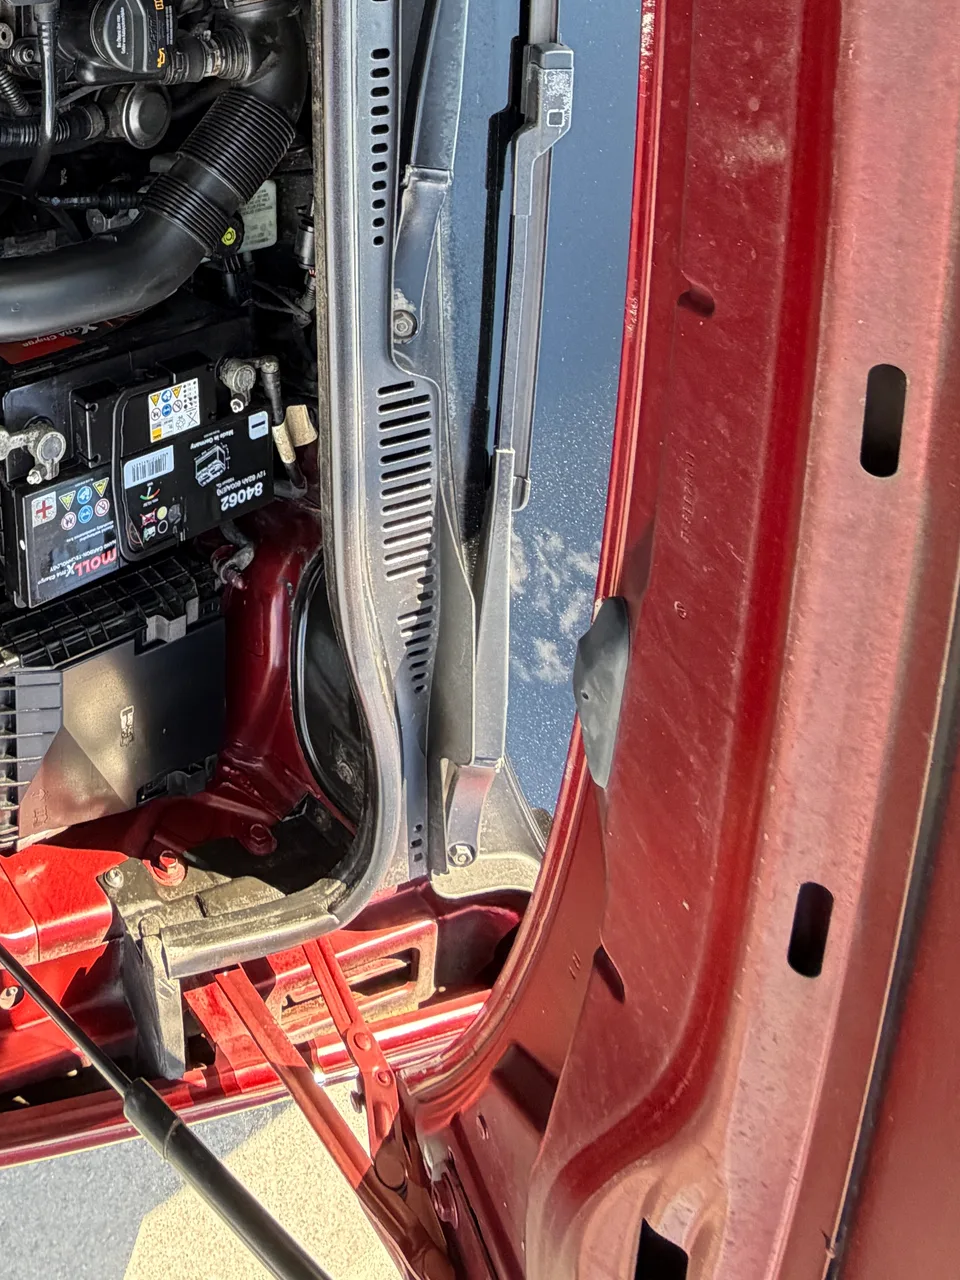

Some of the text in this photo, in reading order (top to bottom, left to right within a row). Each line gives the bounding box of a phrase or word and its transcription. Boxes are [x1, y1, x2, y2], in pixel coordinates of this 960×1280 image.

[220, 429, 234, 438] Made
[190, 438, 213, 450] Germany
[221, 482, 263, 511] 84062
